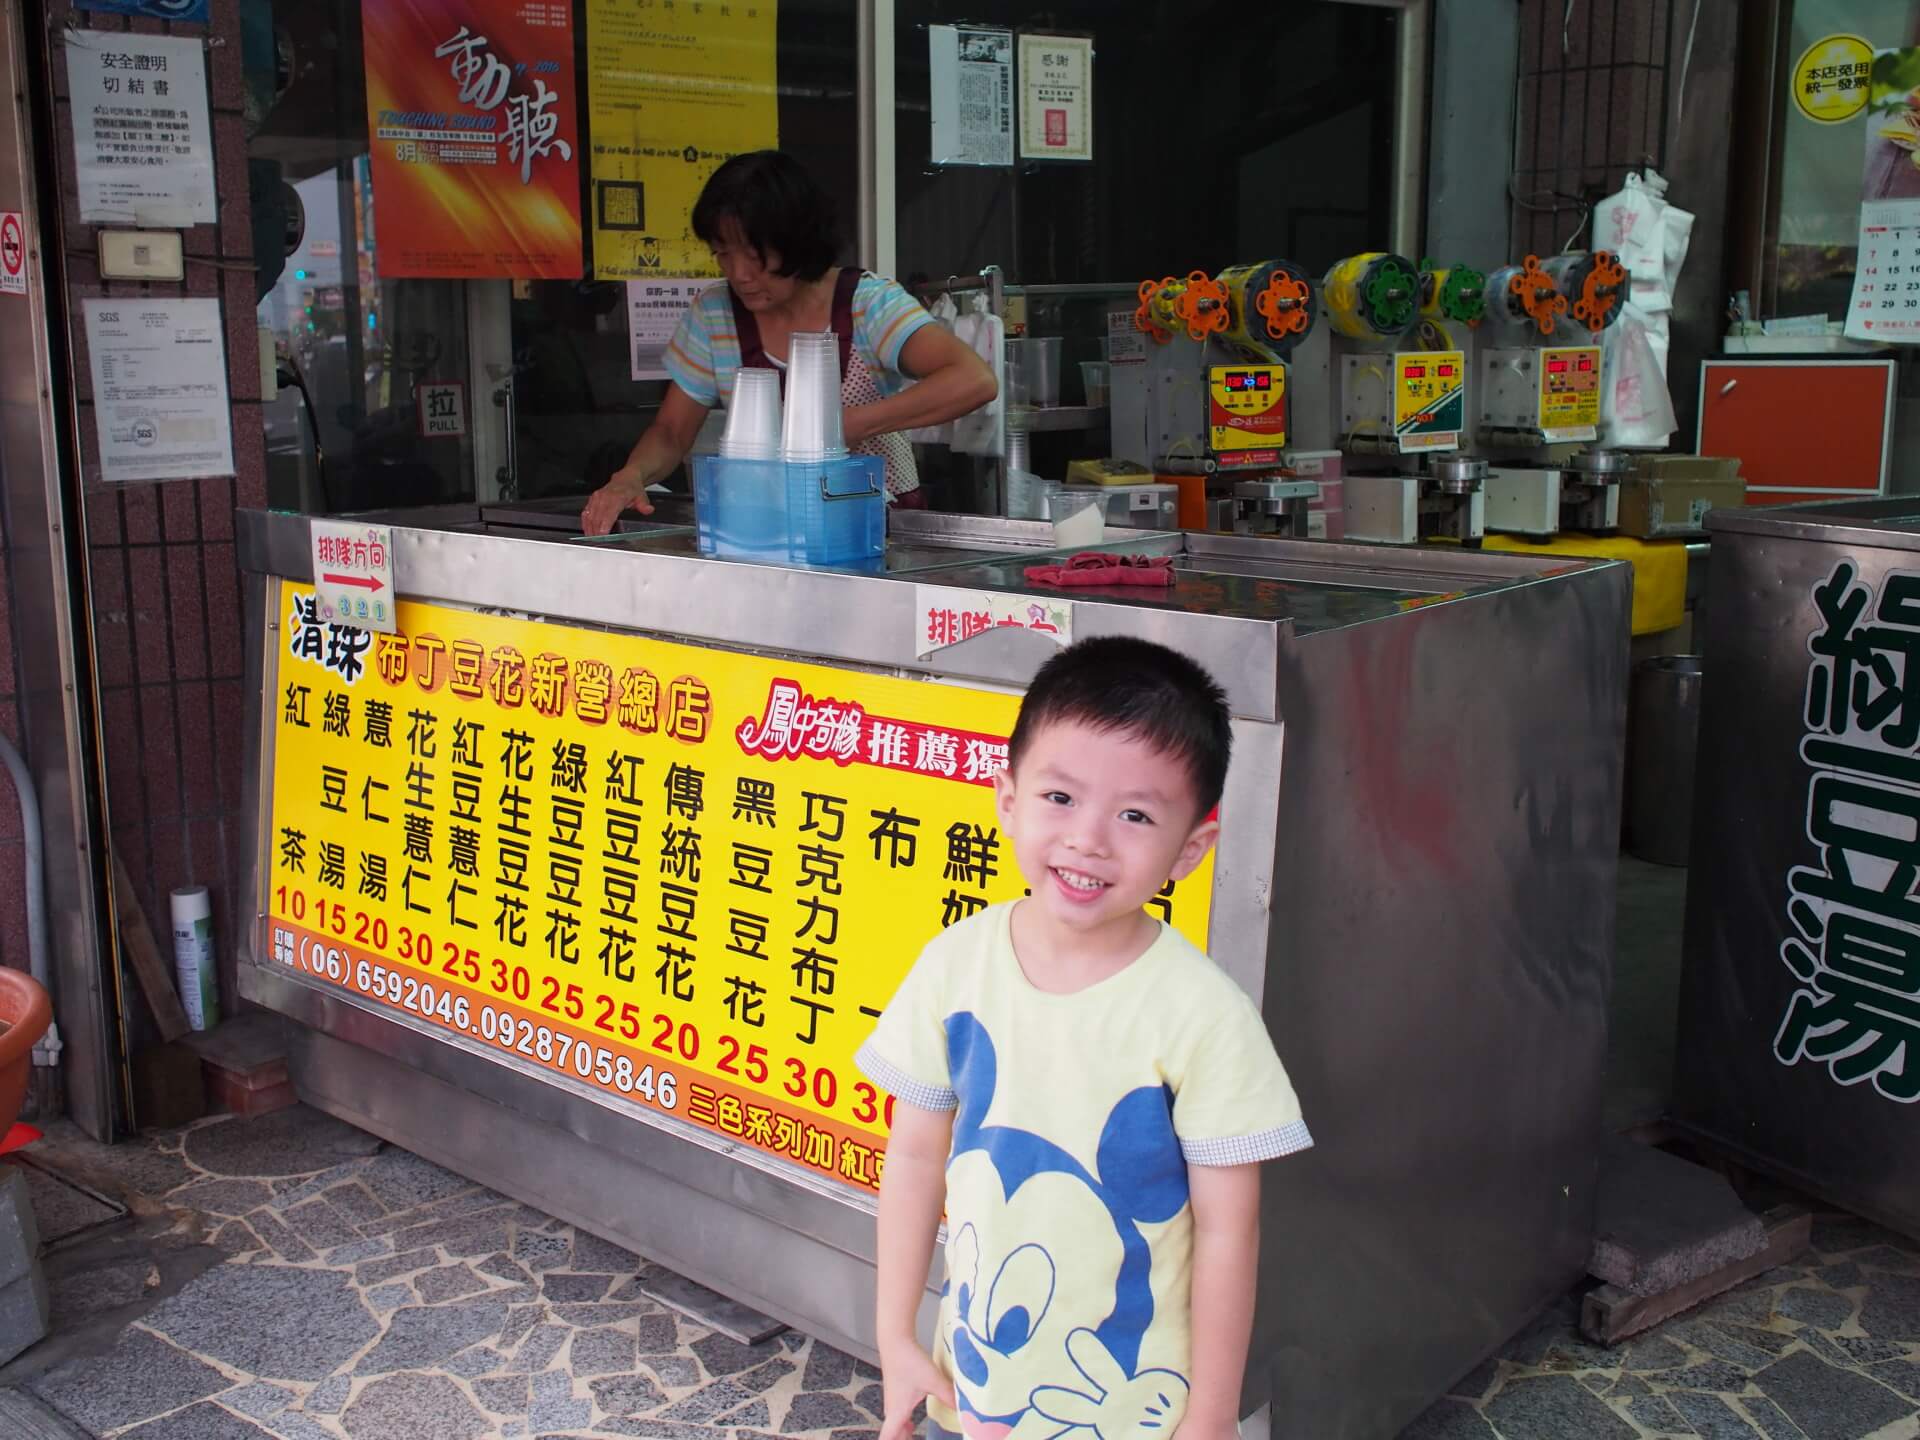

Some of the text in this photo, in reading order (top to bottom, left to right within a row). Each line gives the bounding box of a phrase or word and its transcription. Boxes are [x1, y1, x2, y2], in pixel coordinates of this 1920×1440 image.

[100, 51, 167, 72] 安全證明
[102, 75, 169, 96] 切結書
[1806, 62, 1869, 80] 本店免用
[1806, 76, 1872, 94] 統一發票
[1865, 266, 1878, 276] 14
[1887, 265, 1901, 275] 15
[1892, 248, 1900, 257] 8
[1895, 231, 1901, 240] 1
[99, 311, 120, 323] SGS
[1858, 299, 1918, 309] 28 29 30
[1861, 281, 1920, 293] 21 22 23
[136, 427, 153, 439] SGS
[427, 387, 457, 418] 拉
[428, 419, 458, 431] PULL
[317, 535, 386, 573] 排隊方向
[339, 598, 387, 621] 3 2 1
[291, 595, 710, 744] 清珠 布丁豆花新營總店
[281, 682, 311, 874] 紅茶
[318, 691, 350, 890] 綠豆湯
[358, 700, 393, 902] 薏仁湯
[402, 709, 437, 914] 花生薏仁
[447, 718, 485, 930] 紅豆薏仁
[495, 729, 534, 948] 花生豆花
[545, 739, 588, 964] 綠豆豆花
[598, 750, 644, 982] 紅豆豆花
[1774, 557, 1920, 1104] 綠豆湯
[655, 762, 705, 1001] 傳統豆花
[723, 777, 776, 1027] 黑豆豆花
[790, 791, 848, 1044] 巧克力布丁
[277, 885, 306, 921] 10
[315, 899, 346, 935] 15
[354, 912, 388, 950] 20
[397, 927, 432, 966] 30
[442, 942, 481, 983] 25
[490, 959, 530, 1000] 30
[541, 976, 584, 1019] 25
[595, 994, 640, 1040] 25
[652, 1014, 699, 1061] 20
[717, 1035, 768, 1084] 25
[783, 1058, 837, 1108] 30
[300, 936, 677, 1110] (06)6592046.0928705846
[689, 1083, 834, 1169] 三色系列加
